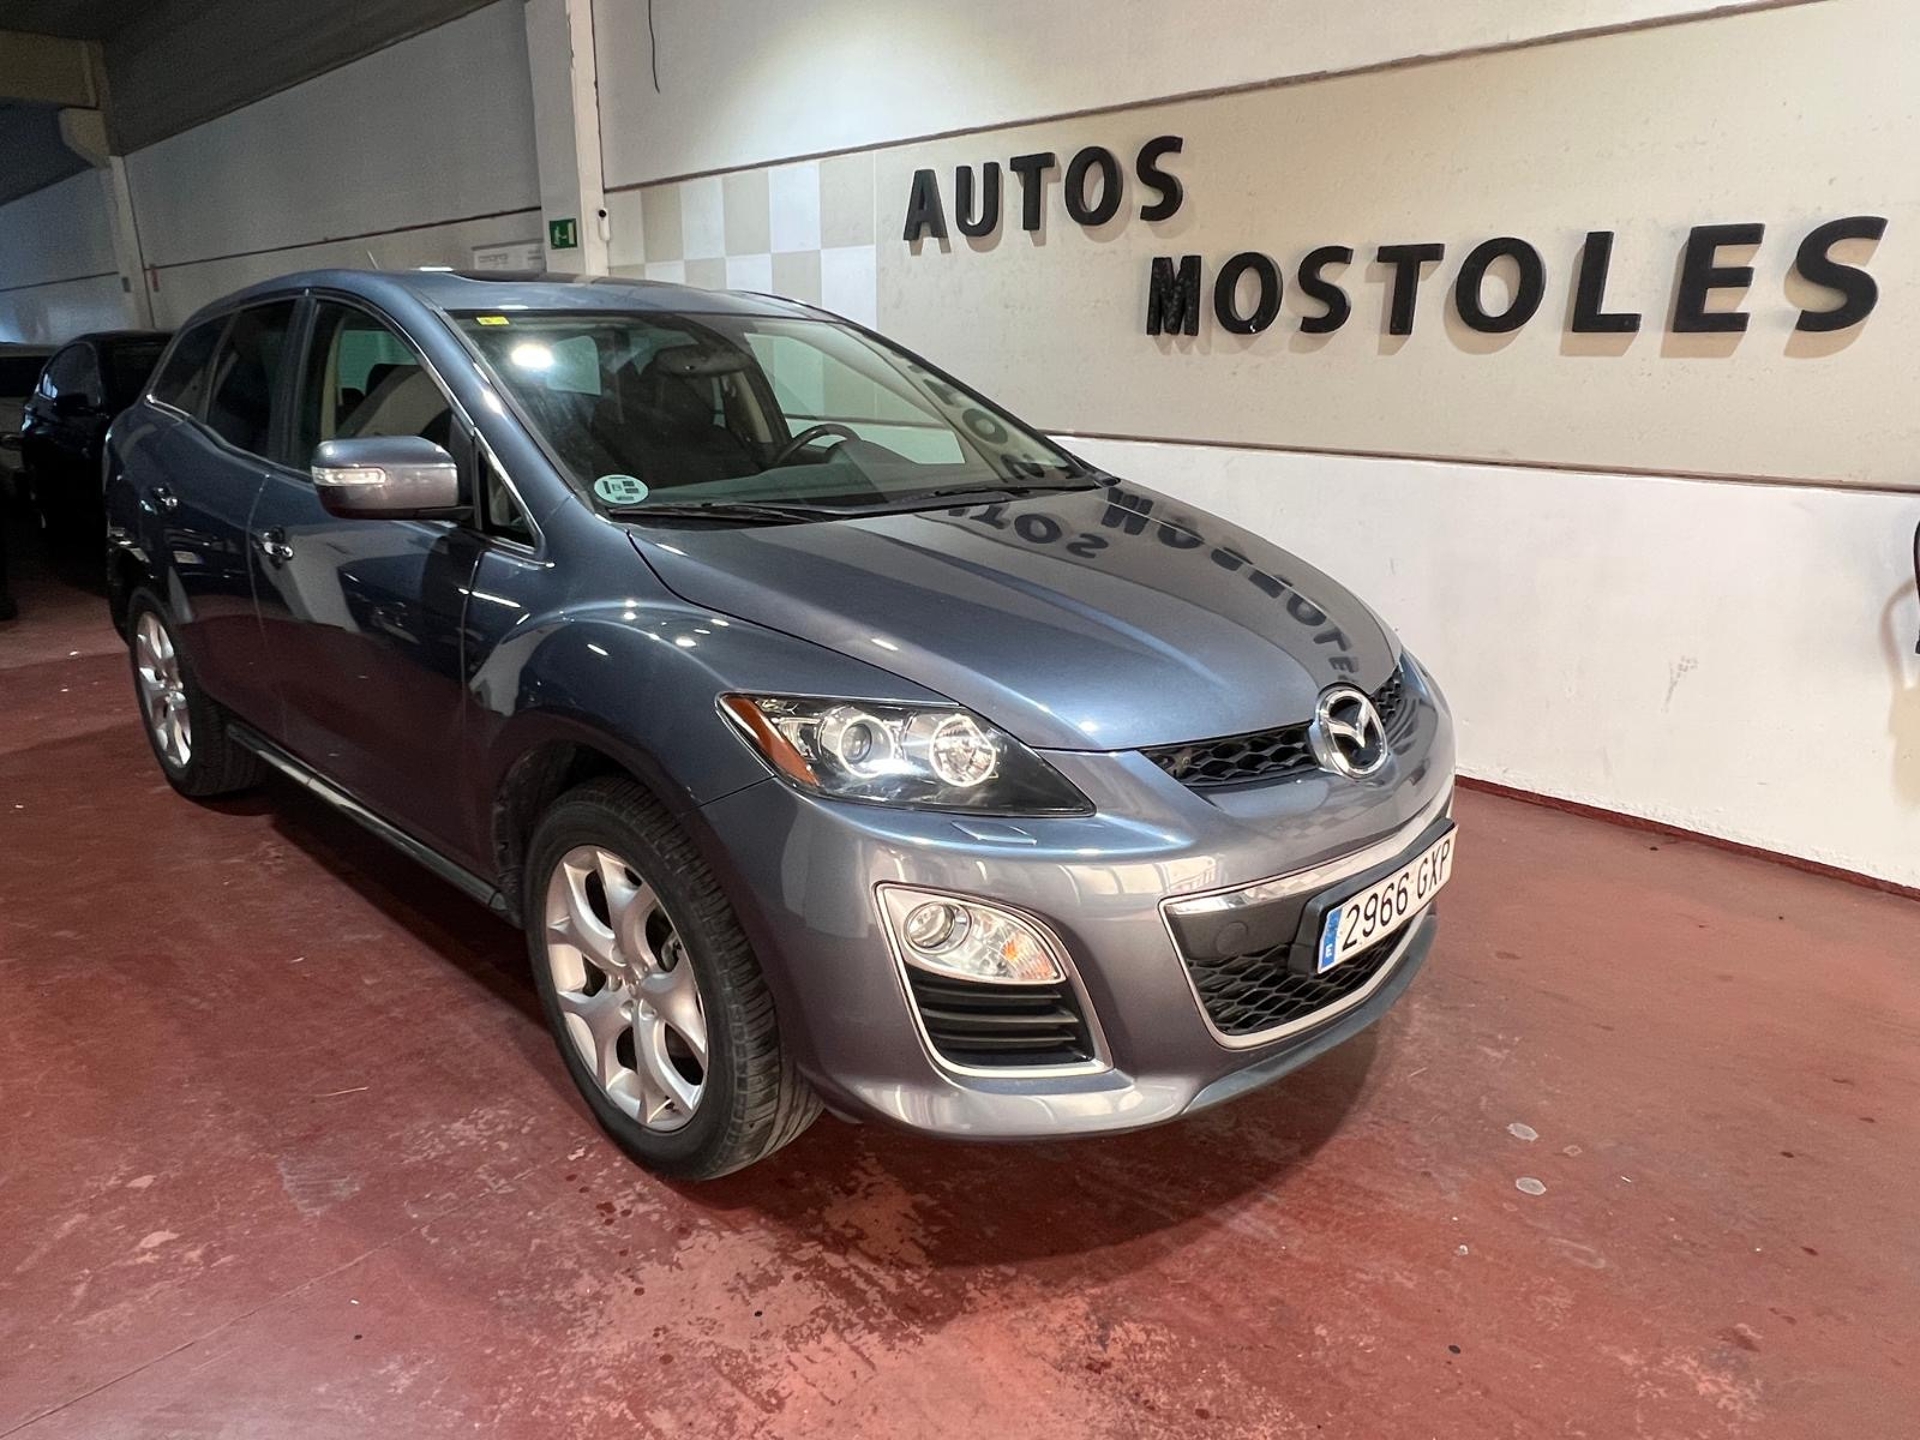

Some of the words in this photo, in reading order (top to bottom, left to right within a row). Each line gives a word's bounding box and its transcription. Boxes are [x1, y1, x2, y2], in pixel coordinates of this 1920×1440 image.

[903, 134, 1185, 241] AUTOS
[1146, 215, 1889, 335] MOSTOLES
[1341, 871, 1410, 953] 2966
[1416, 838, 1451, 901] GXP
